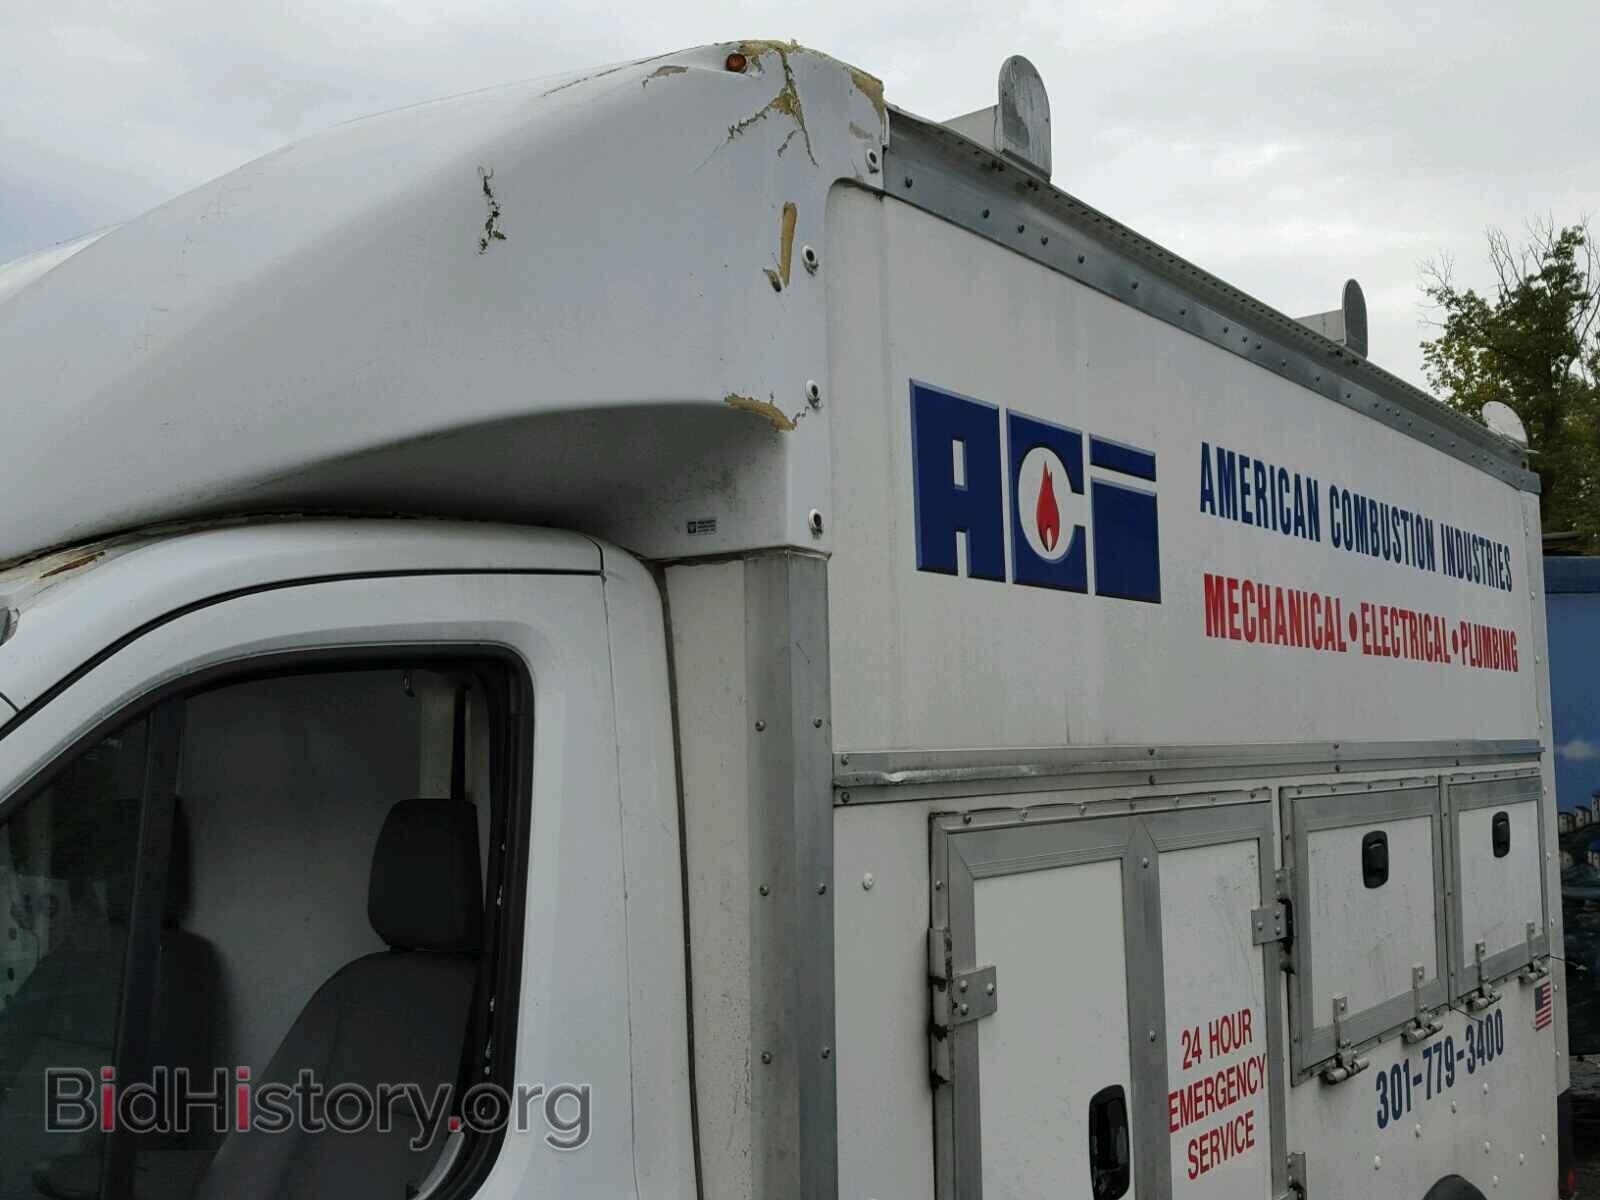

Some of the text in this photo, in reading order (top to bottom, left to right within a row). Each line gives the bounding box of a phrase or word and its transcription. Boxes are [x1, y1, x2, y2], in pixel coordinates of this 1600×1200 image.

[1200, 441, 1513, 592] AMERICAN COMBUSTION INDUSTRIES
[1203, 573, 1519, 672] MECHANICAL ELECTRICAL PLUMBING
[1181, 1007, 1253, 1070] 24 HOUR
[1376, 1008, 1505, 1130] 301-779-3400
[1168, 1052, 1268, 1134] EMERGENCY
[1187, 1109, 1255, 1181] SERVICE
